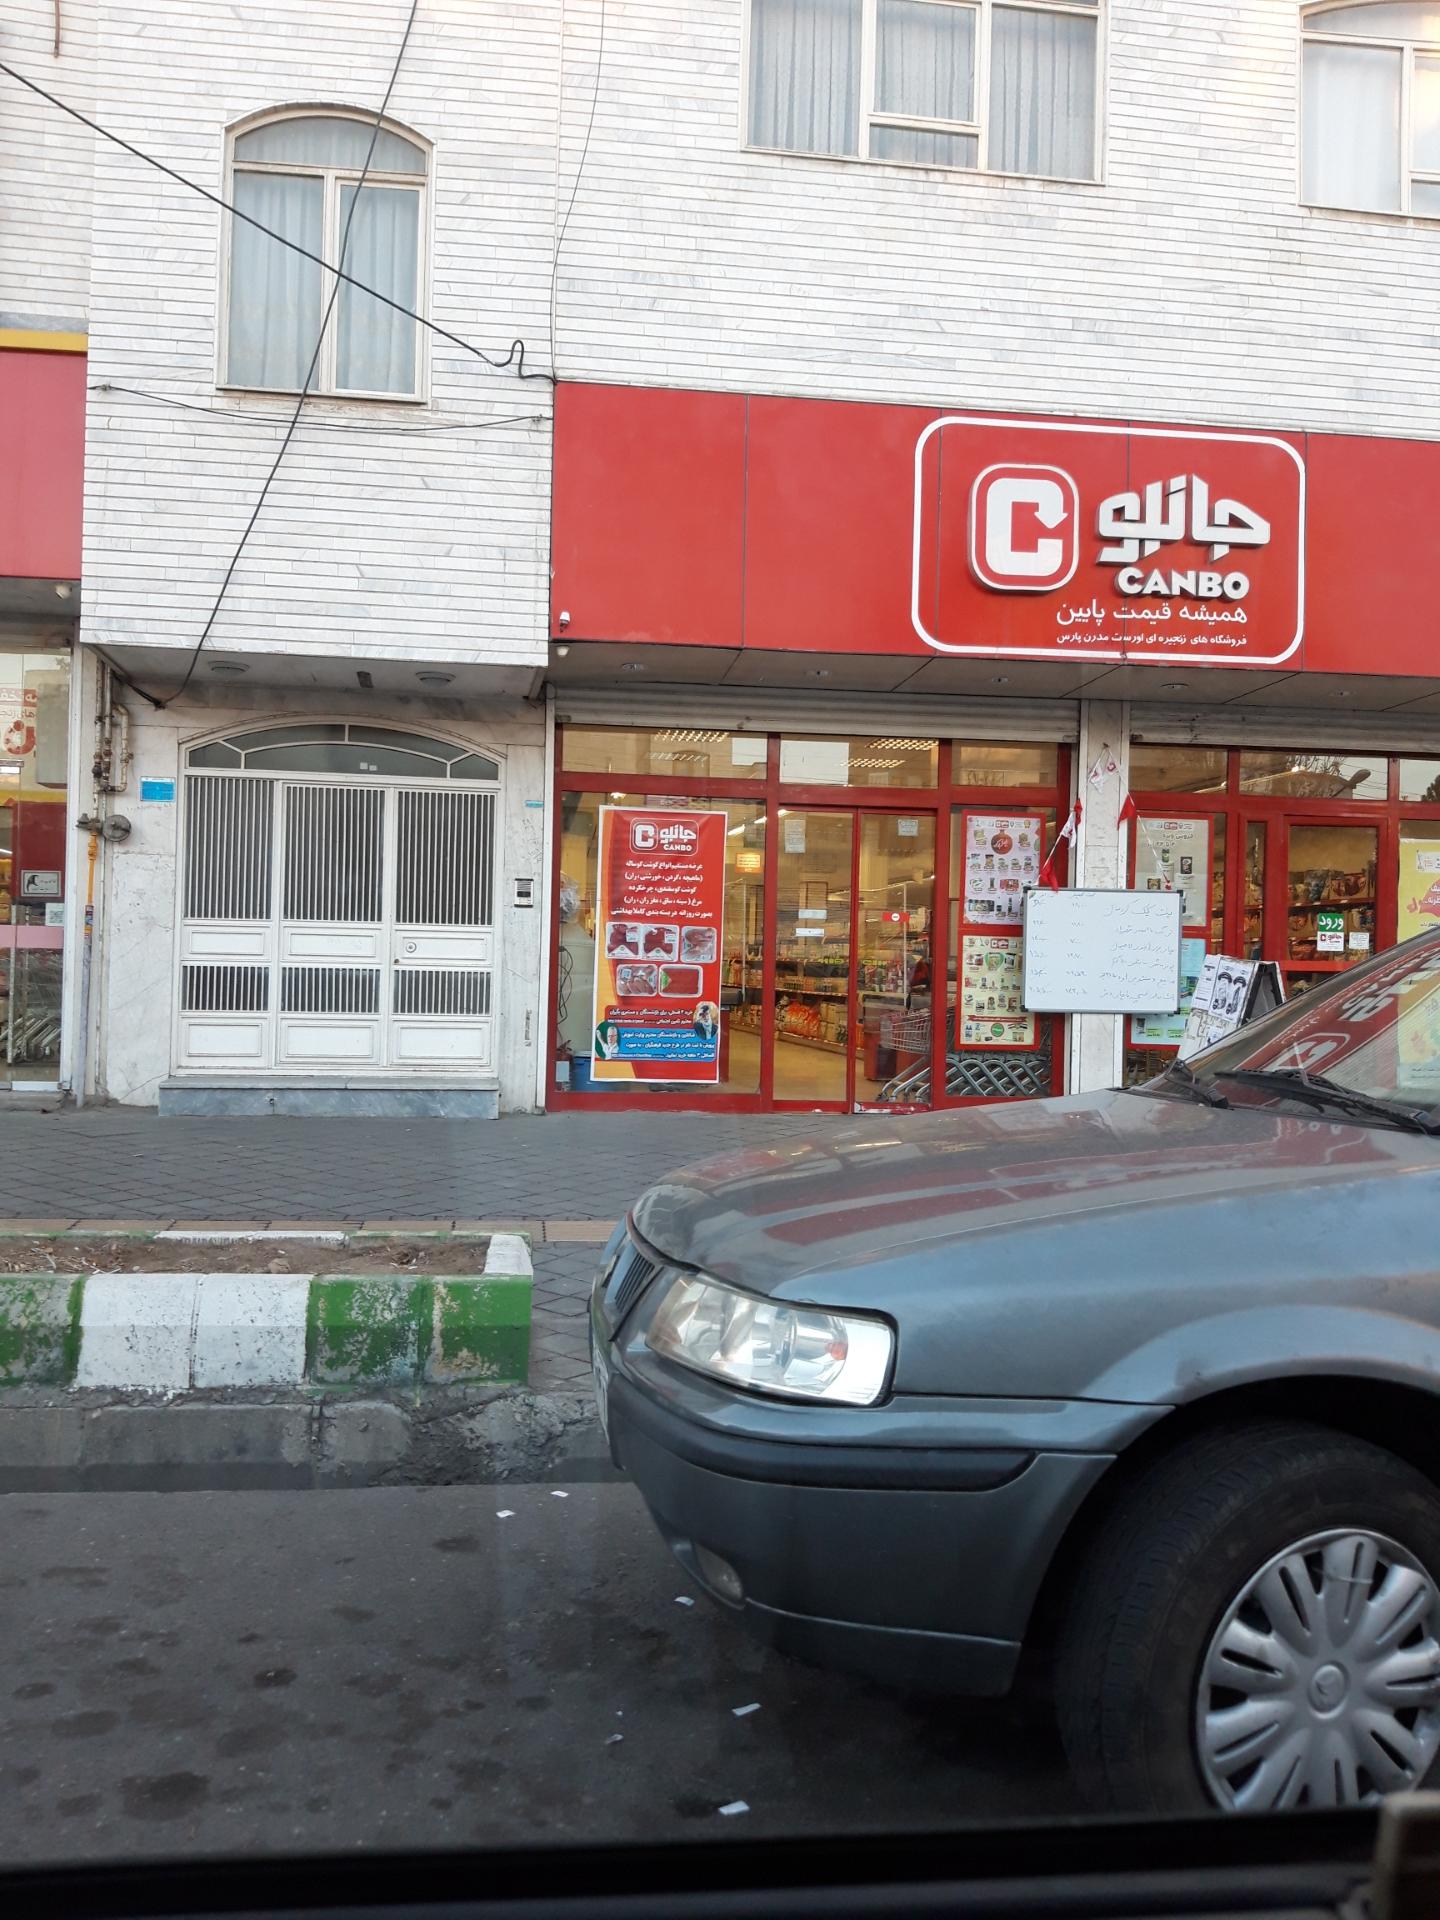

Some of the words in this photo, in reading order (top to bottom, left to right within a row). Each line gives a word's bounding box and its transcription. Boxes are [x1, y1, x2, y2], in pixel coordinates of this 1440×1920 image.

[1096, 474, 1271, 565] جانبو
[1116, 566, 1250, 600] CANBO
[1056, 598, 1106, 626] پایین
[1112, 602, 1172, 625] قیمت
[1178, 604, 1248, 626] همیشه
[1056, 631, 1082, 644] پارس
[1083, 632, 1109, 643] مدرن
[1111, 632, 1144, 644] اورست
[1145, 633, 1157, 644] ای
[1158, 633, 1187, 645] زنجیره
[1190, 633, 1208, 644] های
[1209, 633, 1247, 647] فروشگاه
[1318, 915, 1344, 930] ورود
